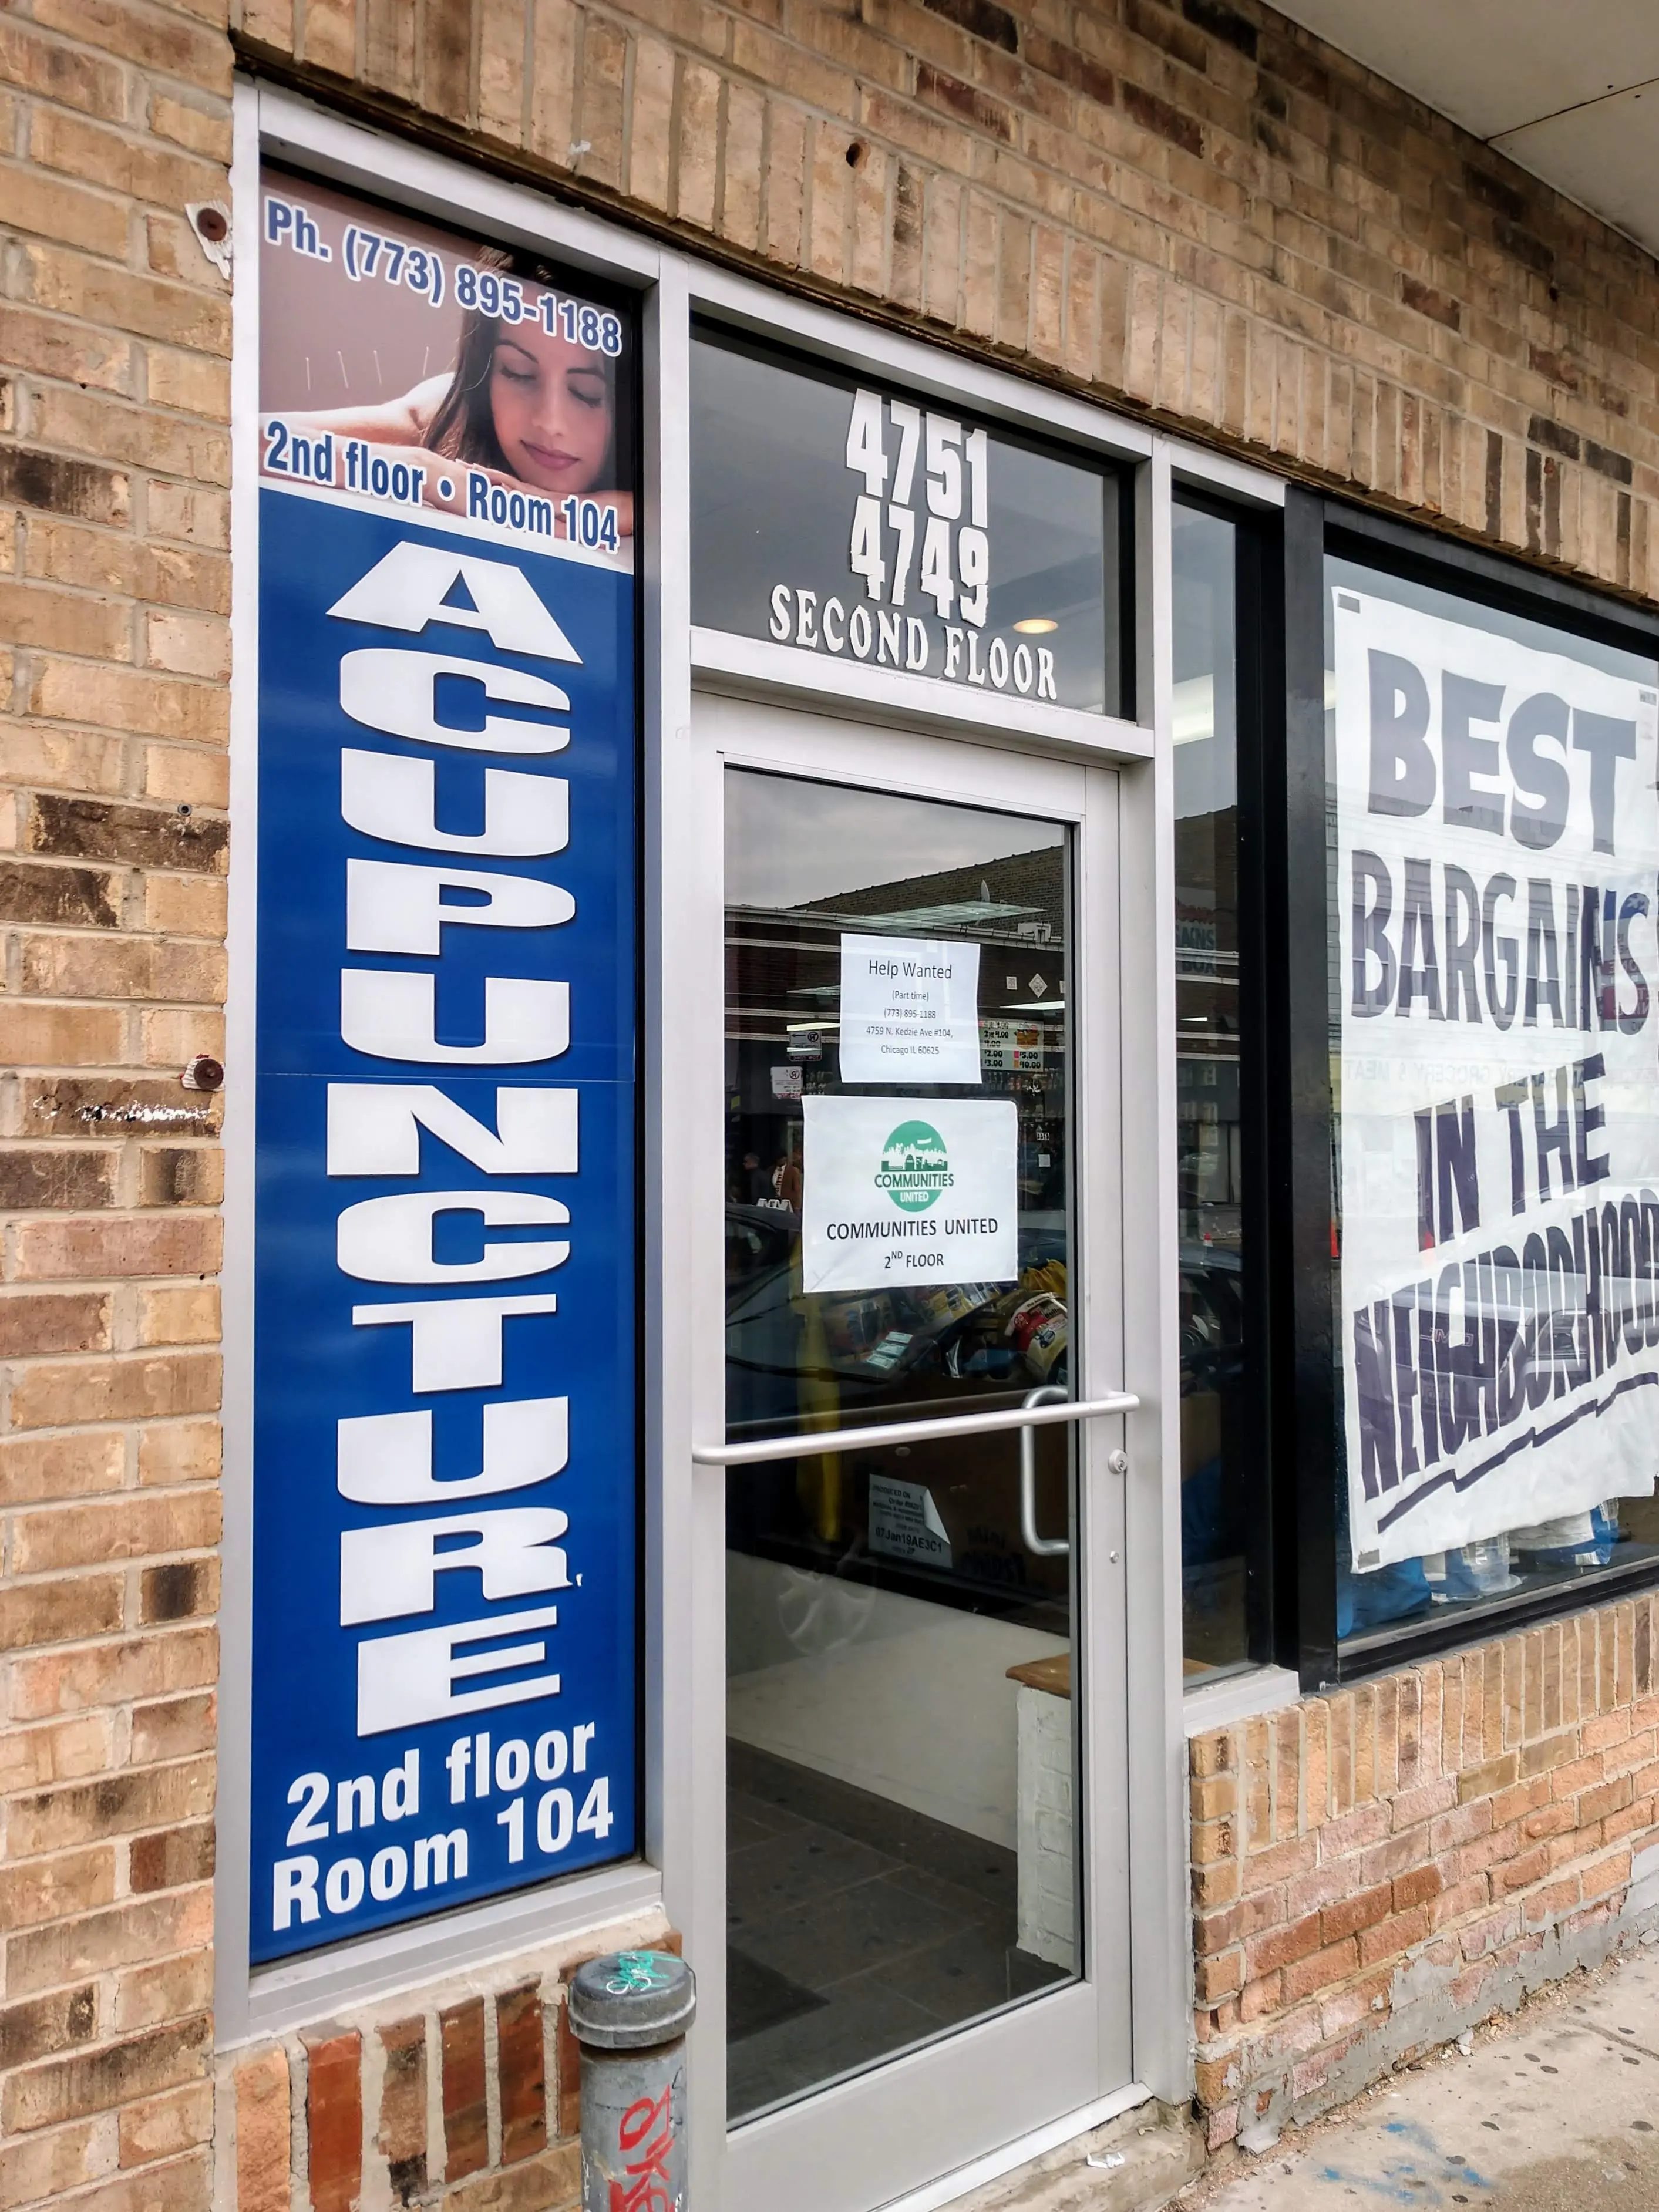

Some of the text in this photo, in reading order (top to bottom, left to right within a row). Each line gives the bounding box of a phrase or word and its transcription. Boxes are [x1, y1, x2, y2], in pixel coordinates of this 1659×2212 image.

[265, 196, 622, 357] Ph. (773) 895-1188
[264, 420, 620, 554] 2nd floor Room 104
[846, 388, 988, 528] 4751
[849, 494, 990, 629] 4749
[769, 584, 1058, 700] SECOND FLOOR
[1367, 648, 1637, 857] BEST
[868, 959, 953, 979] Help Wanted
[891, 989, 930, 1002] (Part time)
[1351, 849, 1650, 1036] BARGAINS
[866, 1026, 953, 1038] 4759 N. Kedzie Ave #104,
[881, 1045, 940, 1056] Chicago IL 60625
[884, 1008, 936, 1019] (773) 895-1188
[984, 1049, 1003, 1058] $2.00
[984, 1059, 1003, 1068] $3.00
[325, 541, 583, 1737] ACUPUNCTURE
[874, 1172, 954, 1189] COMMUNITIES
[900, 1191, 929, 1203] UNITED
[1414, 1052, 1610, 1253] IN THE
[826, 1218, 998, 1240] COMMUNITIES UNITED
[906, 1253, 944, 1268] FLOOR
[1353, 1189, 1659, 1501] NEIGHBORHOOD
[286, 1721, 595, 1847] 2nd floor
[273, 1776, 614, 1932] Room 104
